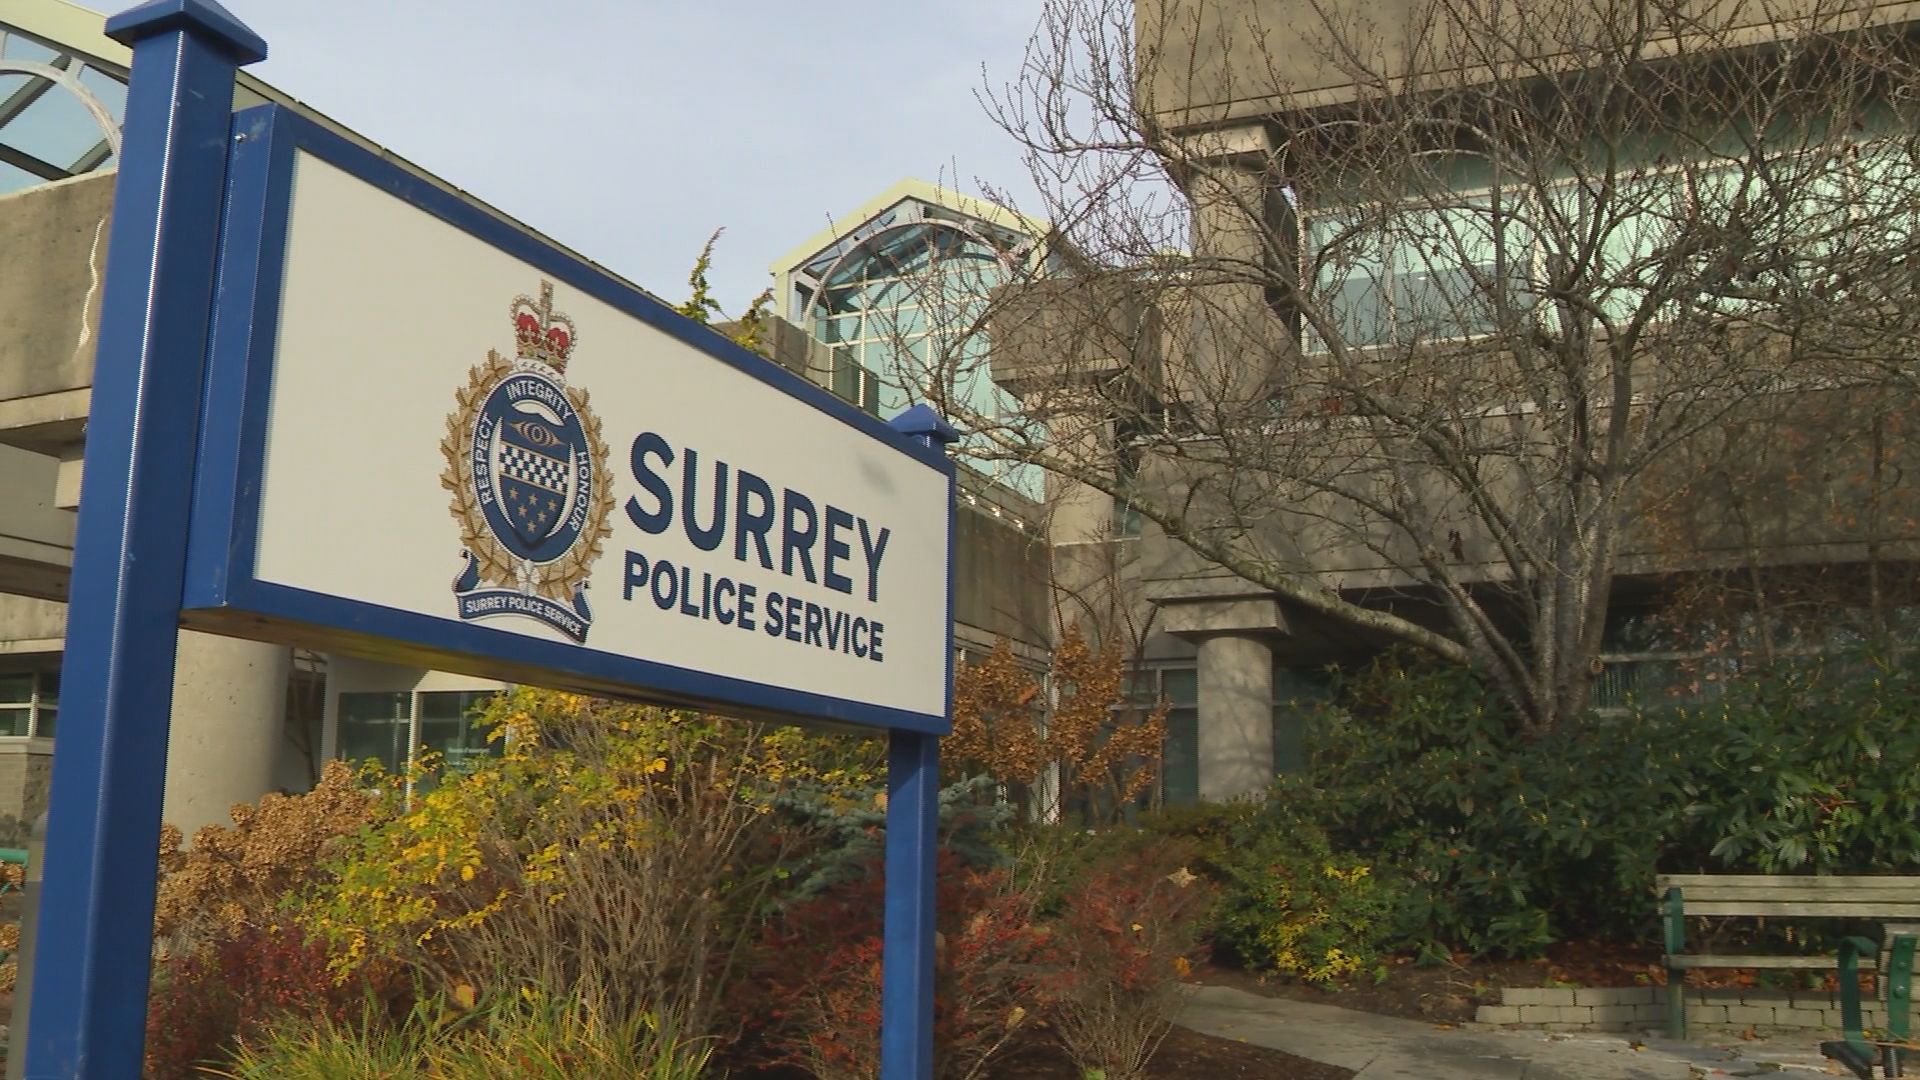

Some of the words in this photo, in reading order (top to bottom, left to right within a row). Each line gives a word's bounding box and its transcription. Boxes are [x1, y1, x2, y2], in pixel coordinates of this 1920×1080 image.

[506, 381, 574, 420] INTEGRITY
[475, 412, 494, 505] RESPECT
[568, 451, 589, 532] HONOUR
[624, 431, 891, 603] SURREY
[465, 596, 507, 613] SURREY
[508, 597, 544, 615] POLICE
[543, 605, 582, 636] SERVICE
[623, 549, 757, 631] POLICE
[764, 591, 884, 662] SERVICE
